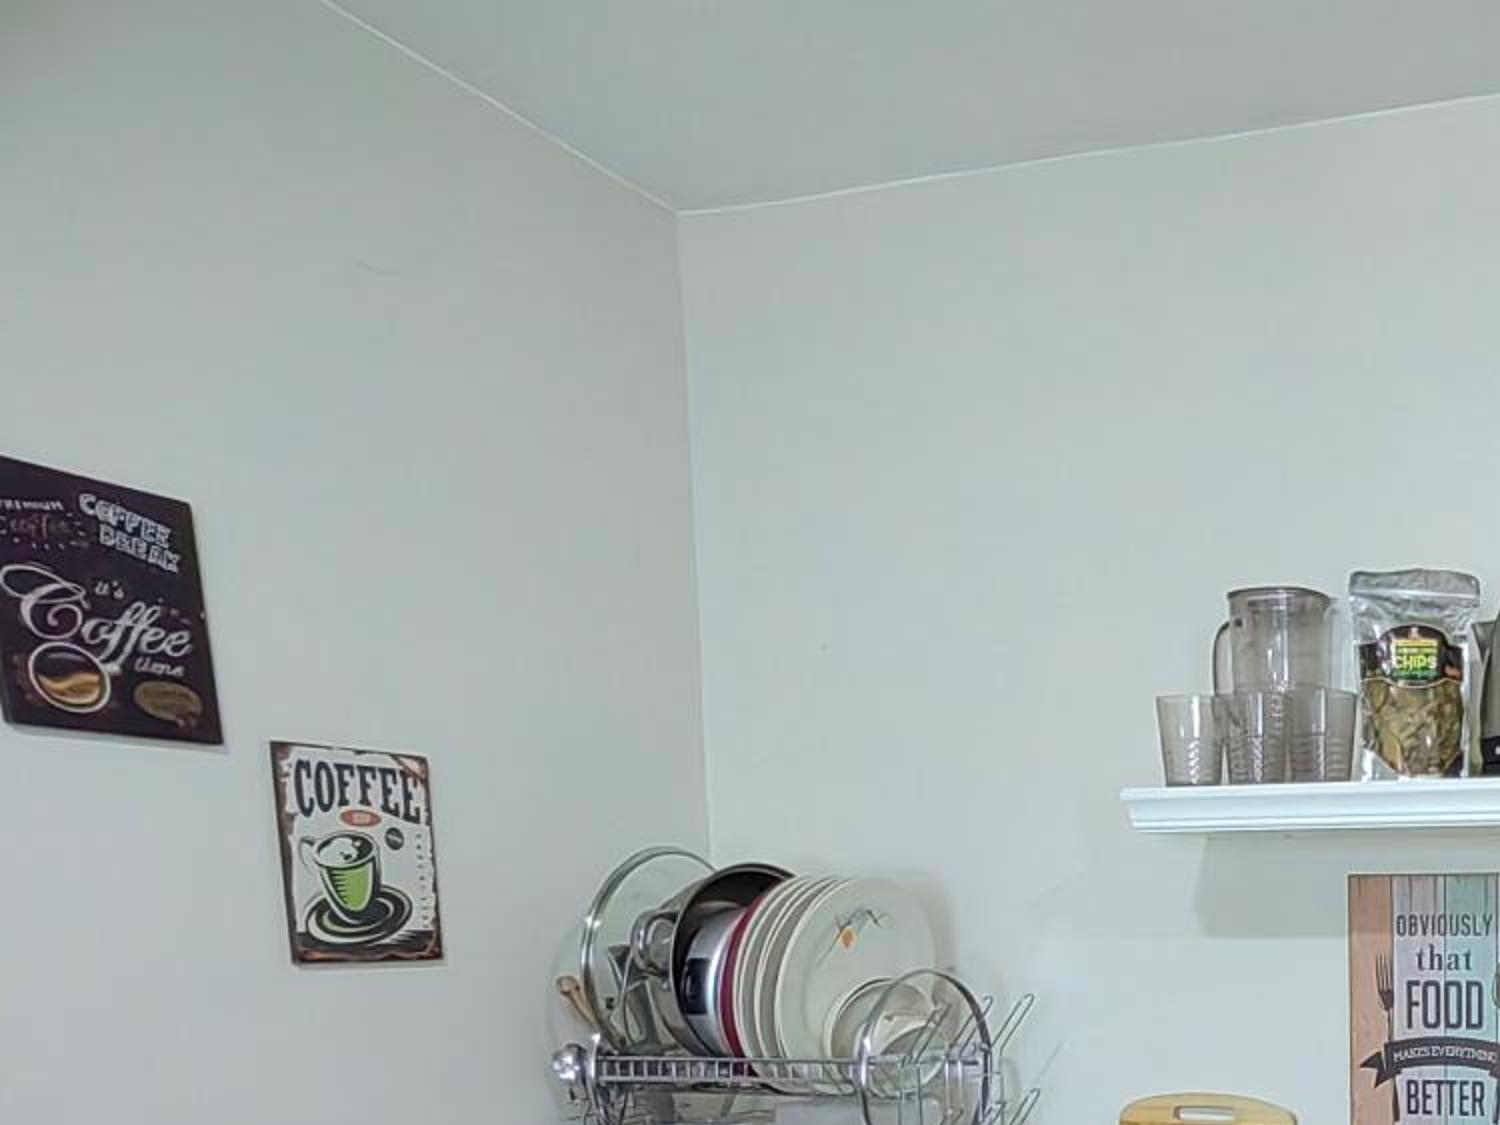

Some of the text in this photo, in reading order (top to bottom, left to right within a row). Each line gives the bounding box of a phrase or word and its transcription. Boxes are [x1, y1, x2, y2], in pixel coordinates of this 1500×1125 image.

[0, 563, 192, 674] Coffee
[1394, 655, 1437, 670] CHIPS
[294, 758, 421, 824] COFFEE
[1396, 914, 1493, 937] OBVIOUSLY
[1416, 944, 1473, 970] that
[1406, 980, 1484, 1029] FOOD
[1406, 1079, 1485, 1117] BETTER
